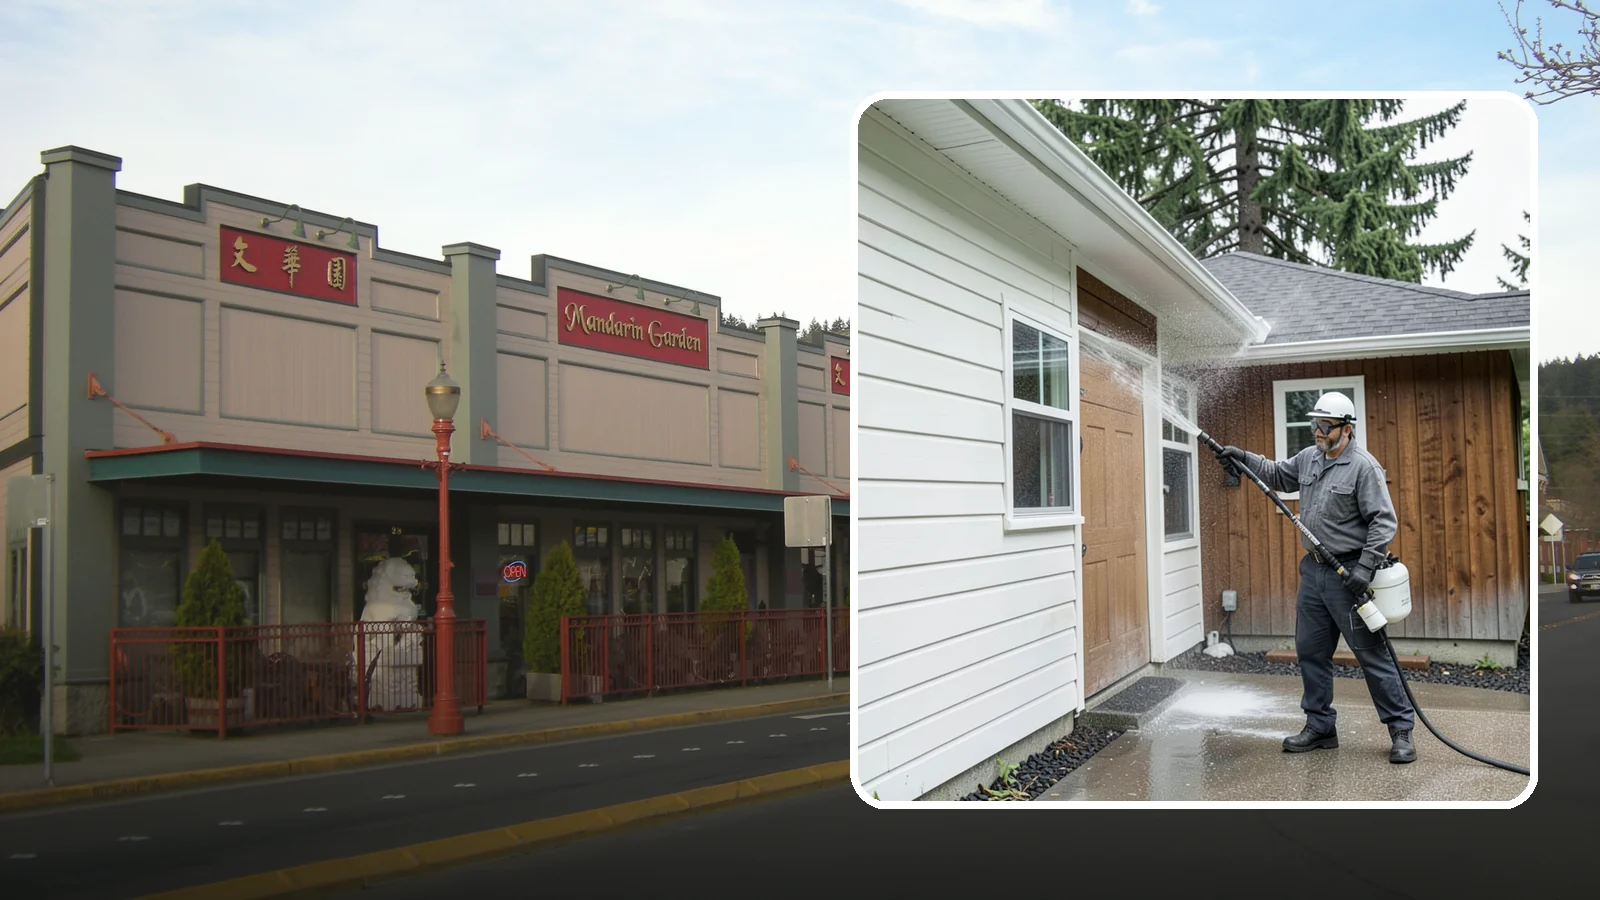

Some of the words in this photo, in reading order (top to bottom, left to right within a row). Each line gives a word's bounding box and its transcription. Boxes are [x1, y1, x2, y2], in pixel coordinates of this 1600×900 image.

[564, 302, 644, 335] Mandarin
[648, 320, 701, 352] Garden
[503, 565, 527, 578] OPEN
